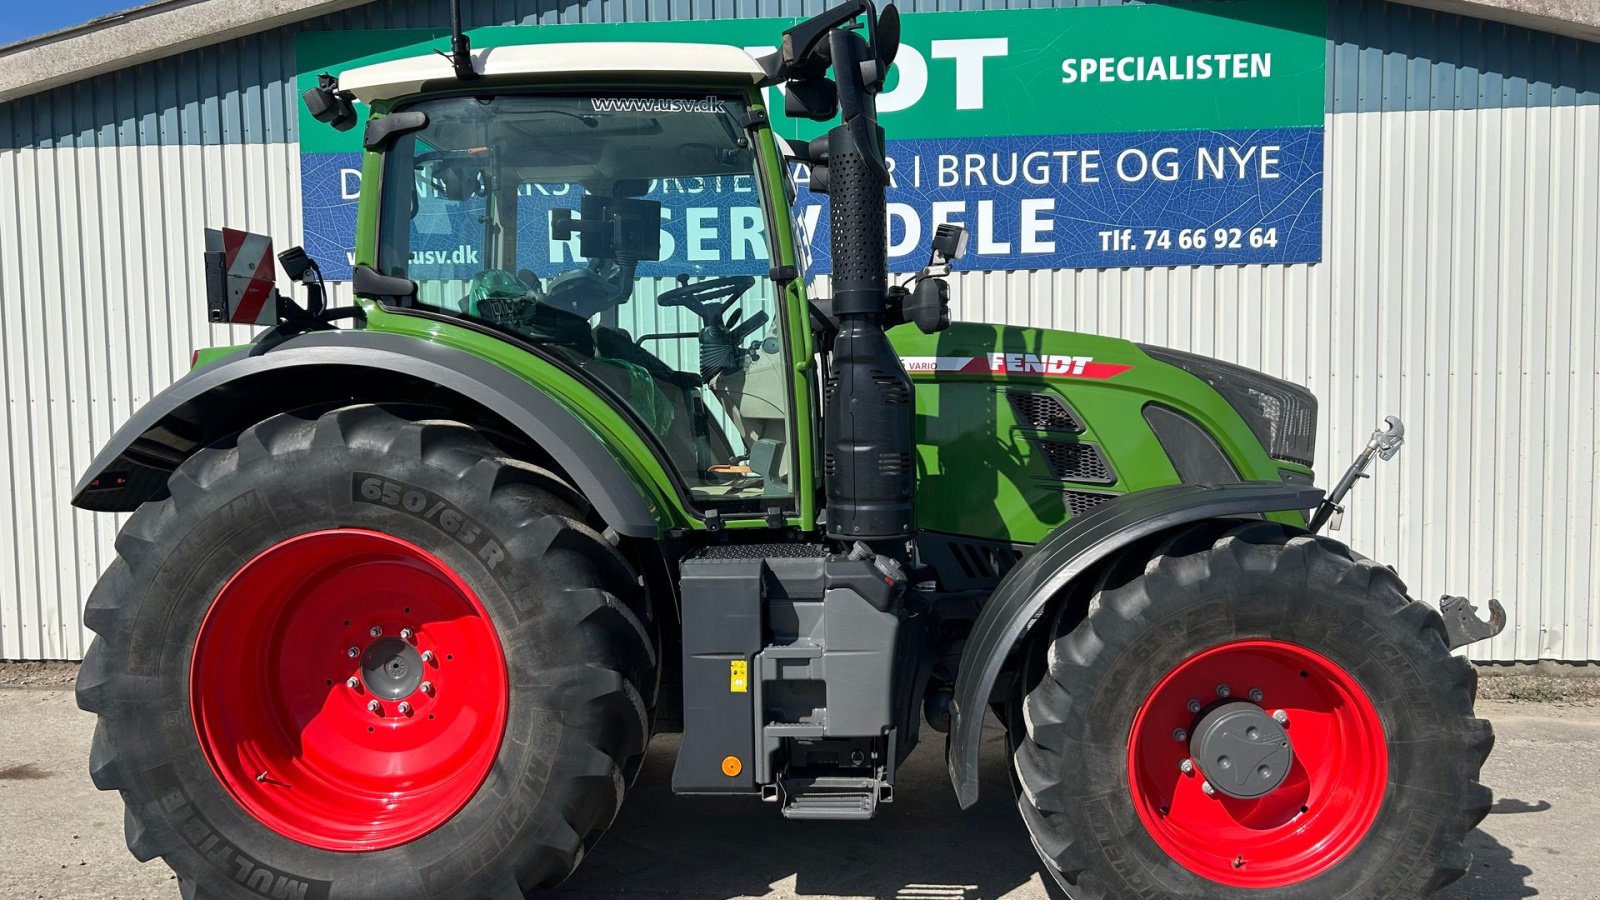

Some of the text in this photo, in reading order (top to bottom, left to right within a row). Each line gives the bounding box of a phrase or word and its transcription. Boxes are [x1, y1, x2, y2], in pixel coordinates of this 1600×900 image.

[1061, 52, 1272, 84] SPECIALISTEN
[591, 96, 725, 113] www.usv.dk
[938, 149, 1099, 188] BRUGTE
[1116, 147, 1179, 182] OG
[1197, 146, 1280, 180] NYE
[1098, 227, 1278, 251] Tlf. 74 66 92 64
[909, 362, 938, 370] VARIO
[986, 352, 1094, 375] FENDT
[360, 477, 483, 544] 650/65
[478, 538, 505, 570] R
